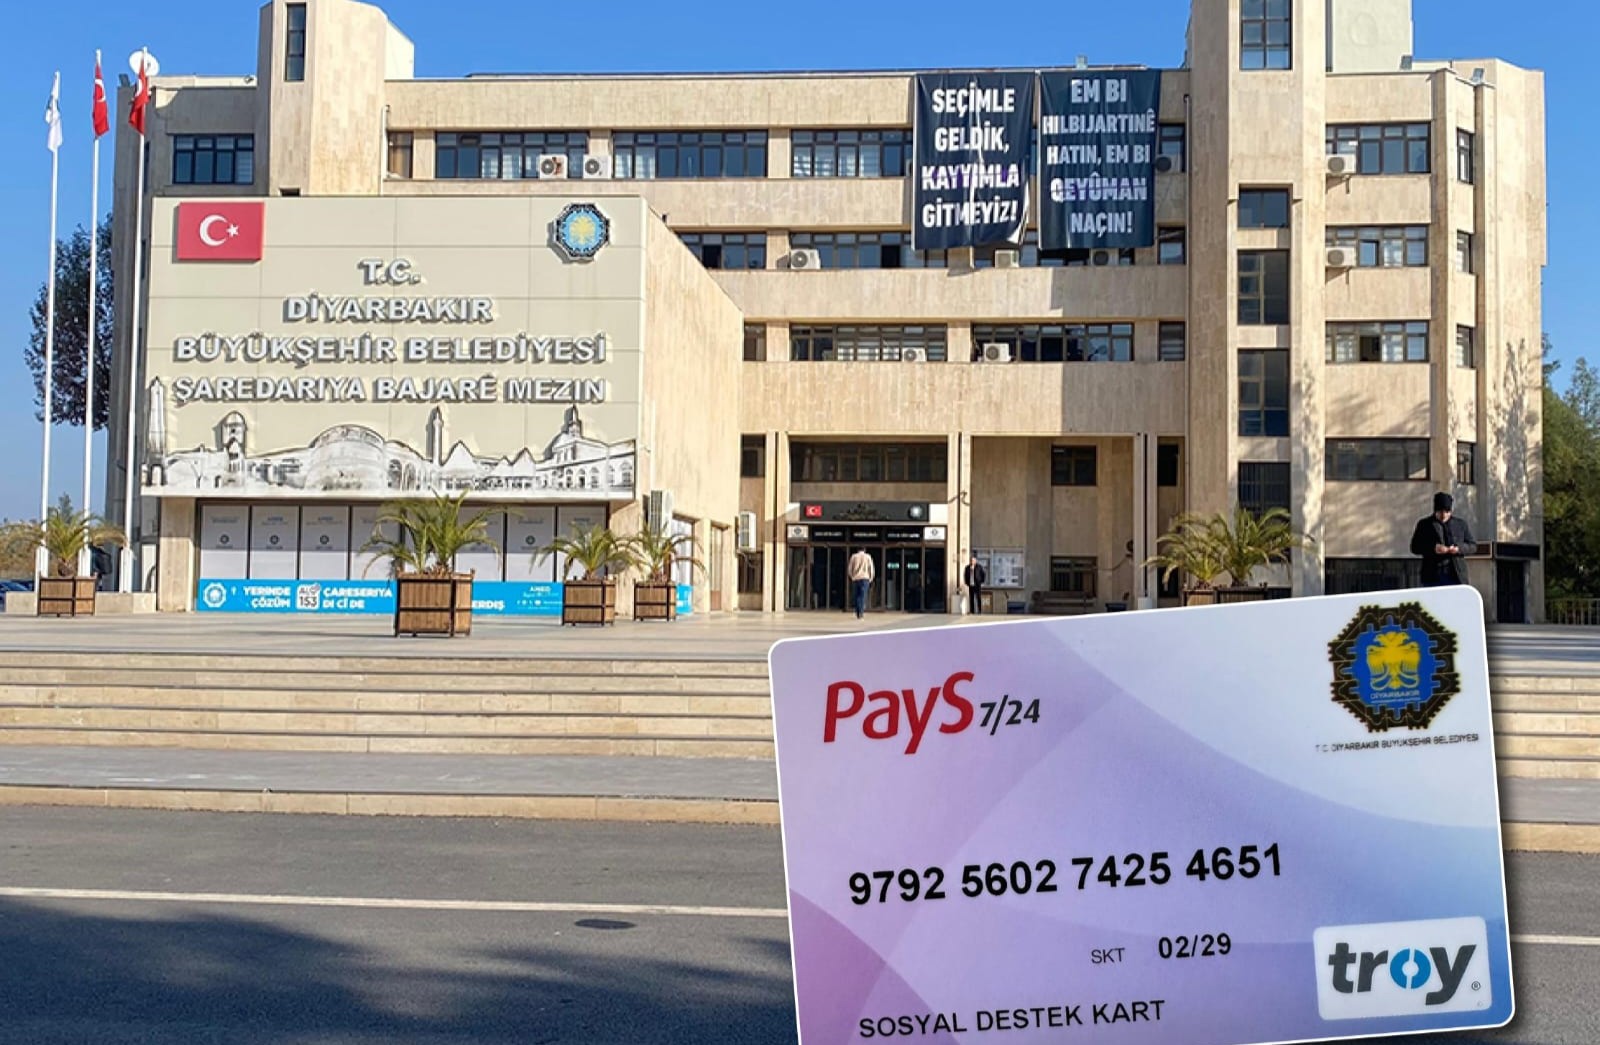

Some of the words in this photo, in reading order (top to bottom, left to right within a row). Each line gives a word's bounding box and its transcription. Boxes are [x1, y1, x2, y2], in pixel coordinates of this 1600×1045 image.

[932, 82, 1015, 117] SEÇİMLE
[1071, 79, 1100, 103] EM
[1105, 79, 1127, 102] BI
[1042, 108, 1155, 135] HILBIJARTINÊ
[934, 122, 1010, 153] GELDİK,
[1047, 145, 1102, 165] HATIN,
[1106, 145, 1130, 164] EM
[1133, 145, 1151, 163] BI
[1050, 171, 1147, 203] QEYÛMAN
[922, 196, 1017, 228] GİTMEYİZ!
[1071, 211, 1133, 238] NAÇIN!
[359, 259, 421, 284] T.C.
[283, 295, 494, 323] DİYARBAKIR
[174, 332, 397, 368] BÜYÜKŞEHİR
[404, 332, 607, 363] BELEDİYESİ
[173, 377, 366, 407] ŞAREDARIYA
[373, 374, 498, 403] BAJARÊ
[504, 378, 606, 403] MEZIN
[300, 596, 318, 607] 153
